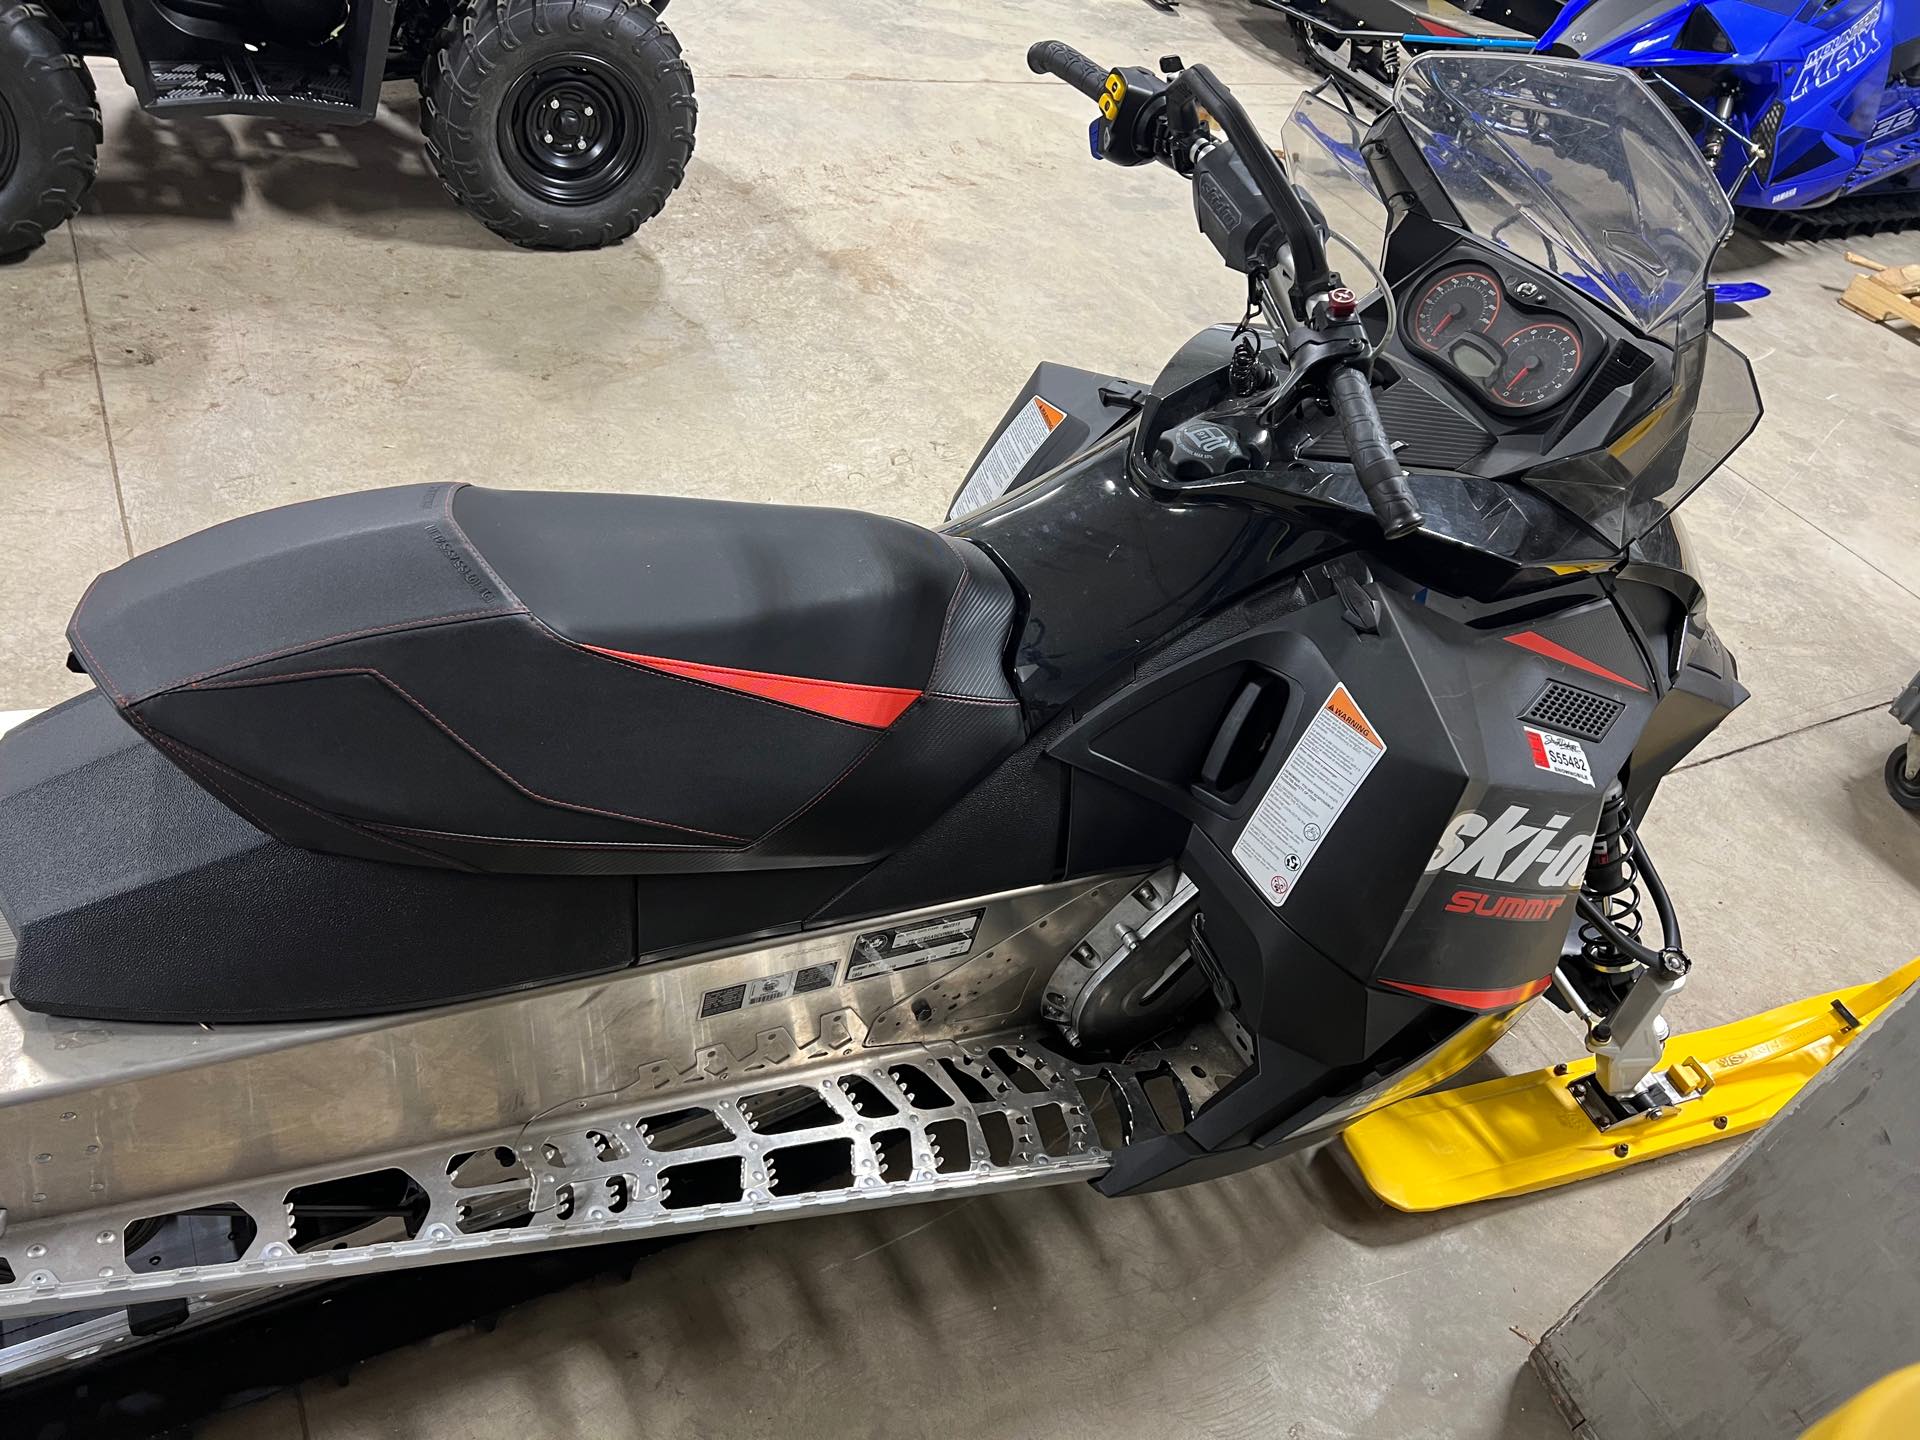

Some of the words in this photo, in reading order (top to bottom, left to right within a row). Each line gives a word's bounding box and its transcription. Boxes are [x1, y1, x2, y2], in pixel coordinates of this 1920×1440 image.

[1791, 25, 1881, 101] MAX
[1335, 708, 1370, 737] WARNING
[1548, 750, 1587, 771] S55482
[1445, 891, 1567, 921] SUMMIT
